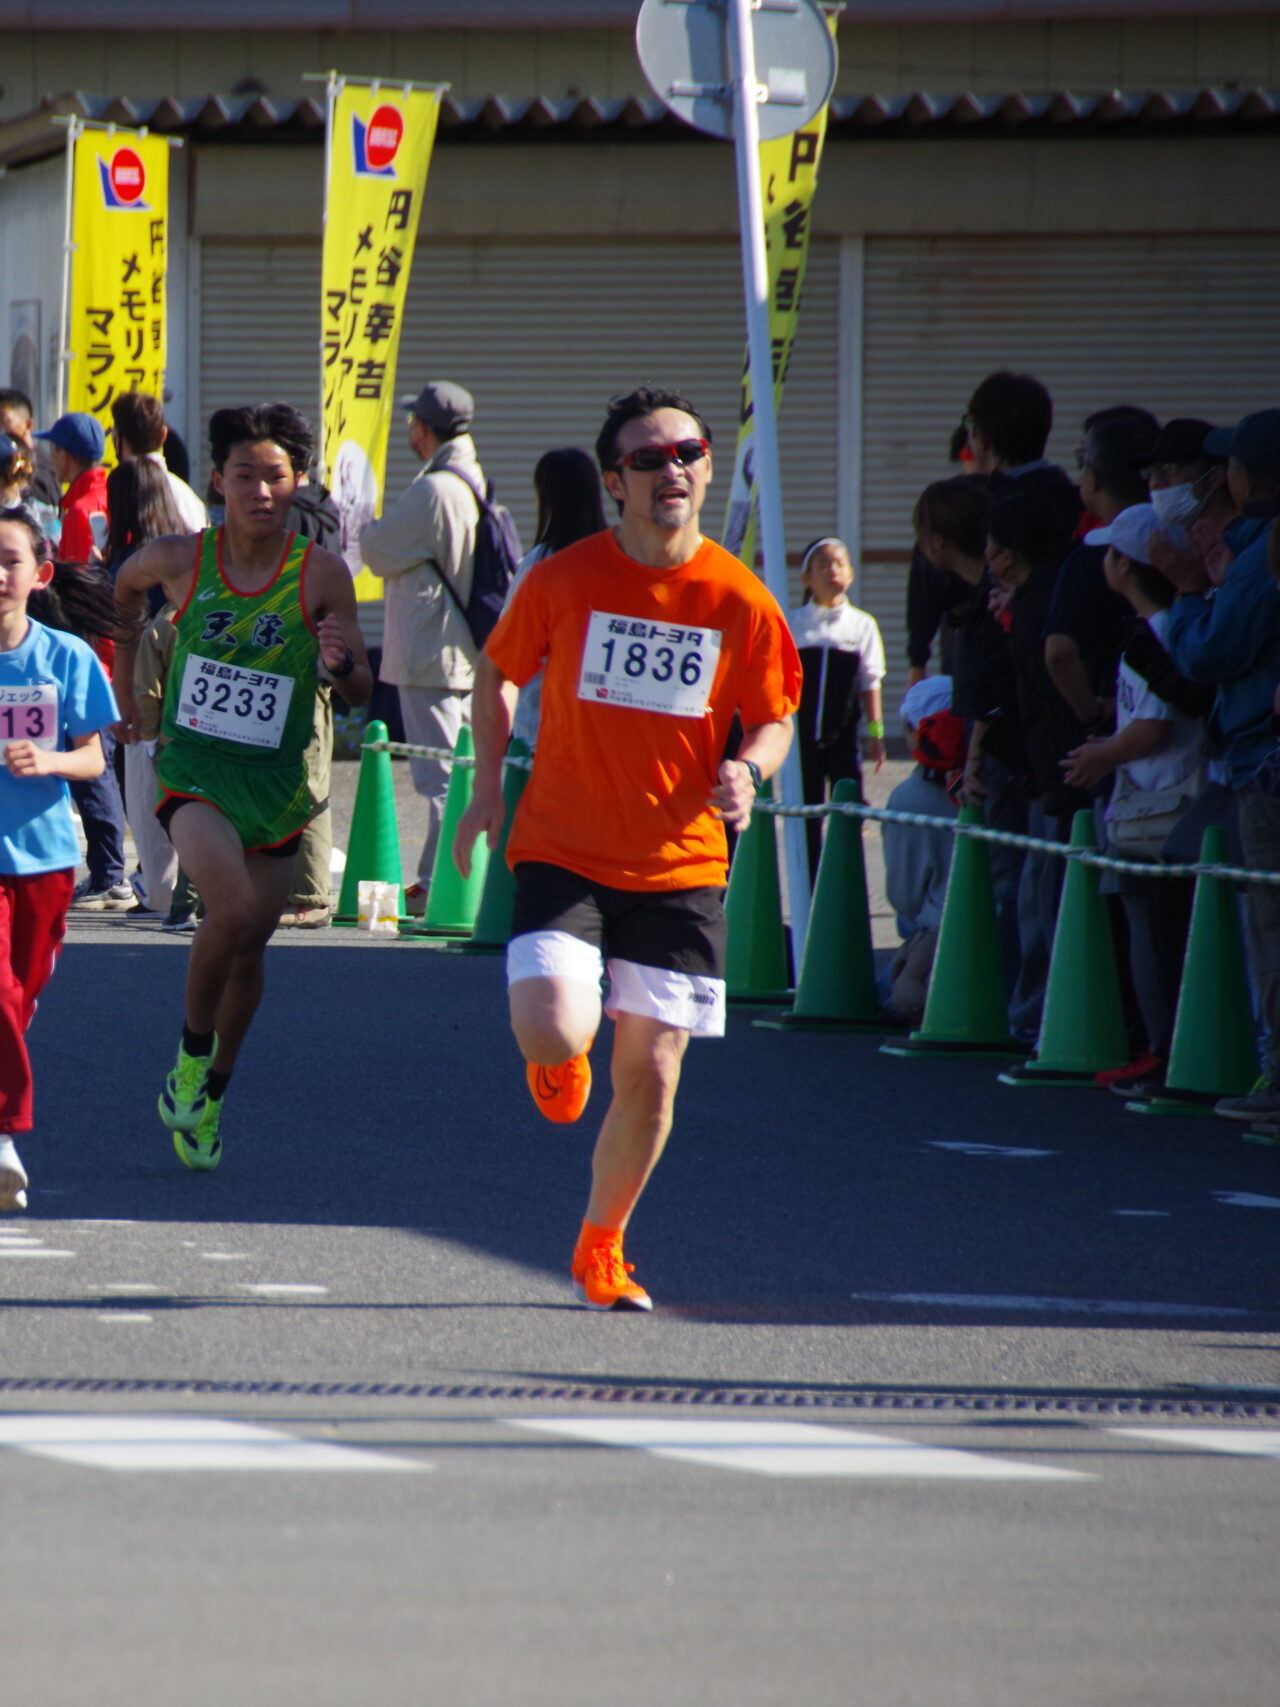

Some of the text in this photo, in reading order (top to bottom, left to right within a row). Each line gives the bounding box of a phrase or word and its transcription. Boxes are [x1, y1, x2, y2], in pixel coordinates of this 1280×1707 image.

[355, 189, 412, 400] 円谷幸吉
[86, 307, 115, 437] マラソ
[608, 619, 703, 647] 福島トヨタ
[199, 661, 279, 690] 福島トヨタ
[602, 638, 703, 686] 1836
[191, 677, 277, 722] 3233
